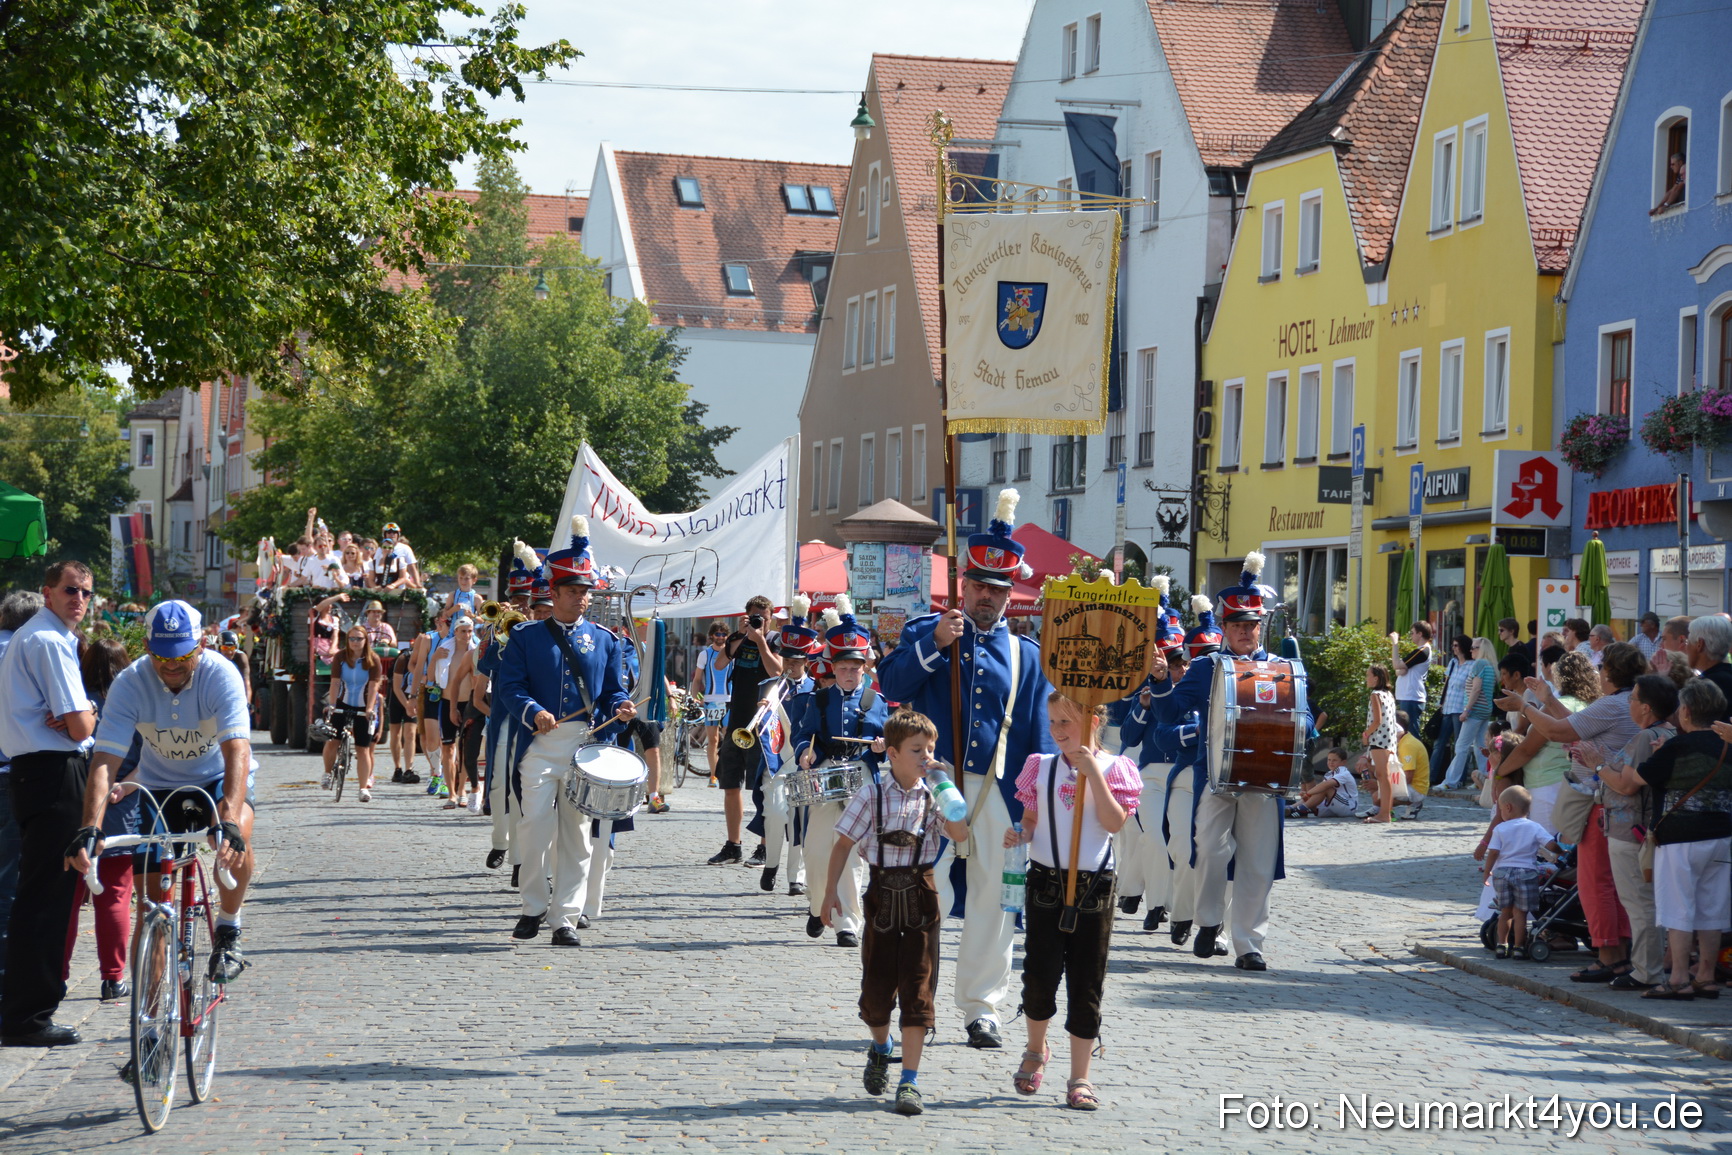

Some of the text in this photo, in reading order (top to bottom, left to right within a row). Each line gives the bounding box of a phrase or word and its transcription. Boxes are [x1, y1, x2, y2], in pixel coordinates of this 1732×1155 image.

[1279, 312, 1375, 359] HOTEL Lehmeier
[974, 359, 1006, 389] Stadt
[1322, 489, 1371, 500] TAIFN
[1268, 506, 1325, 532] Restaurant
[1066, 585, 1140, 604] Tangrintler
[1053, 602, 1148, 633] Spielmannszug
[1060, 673, 1131, 690] HEMAU
